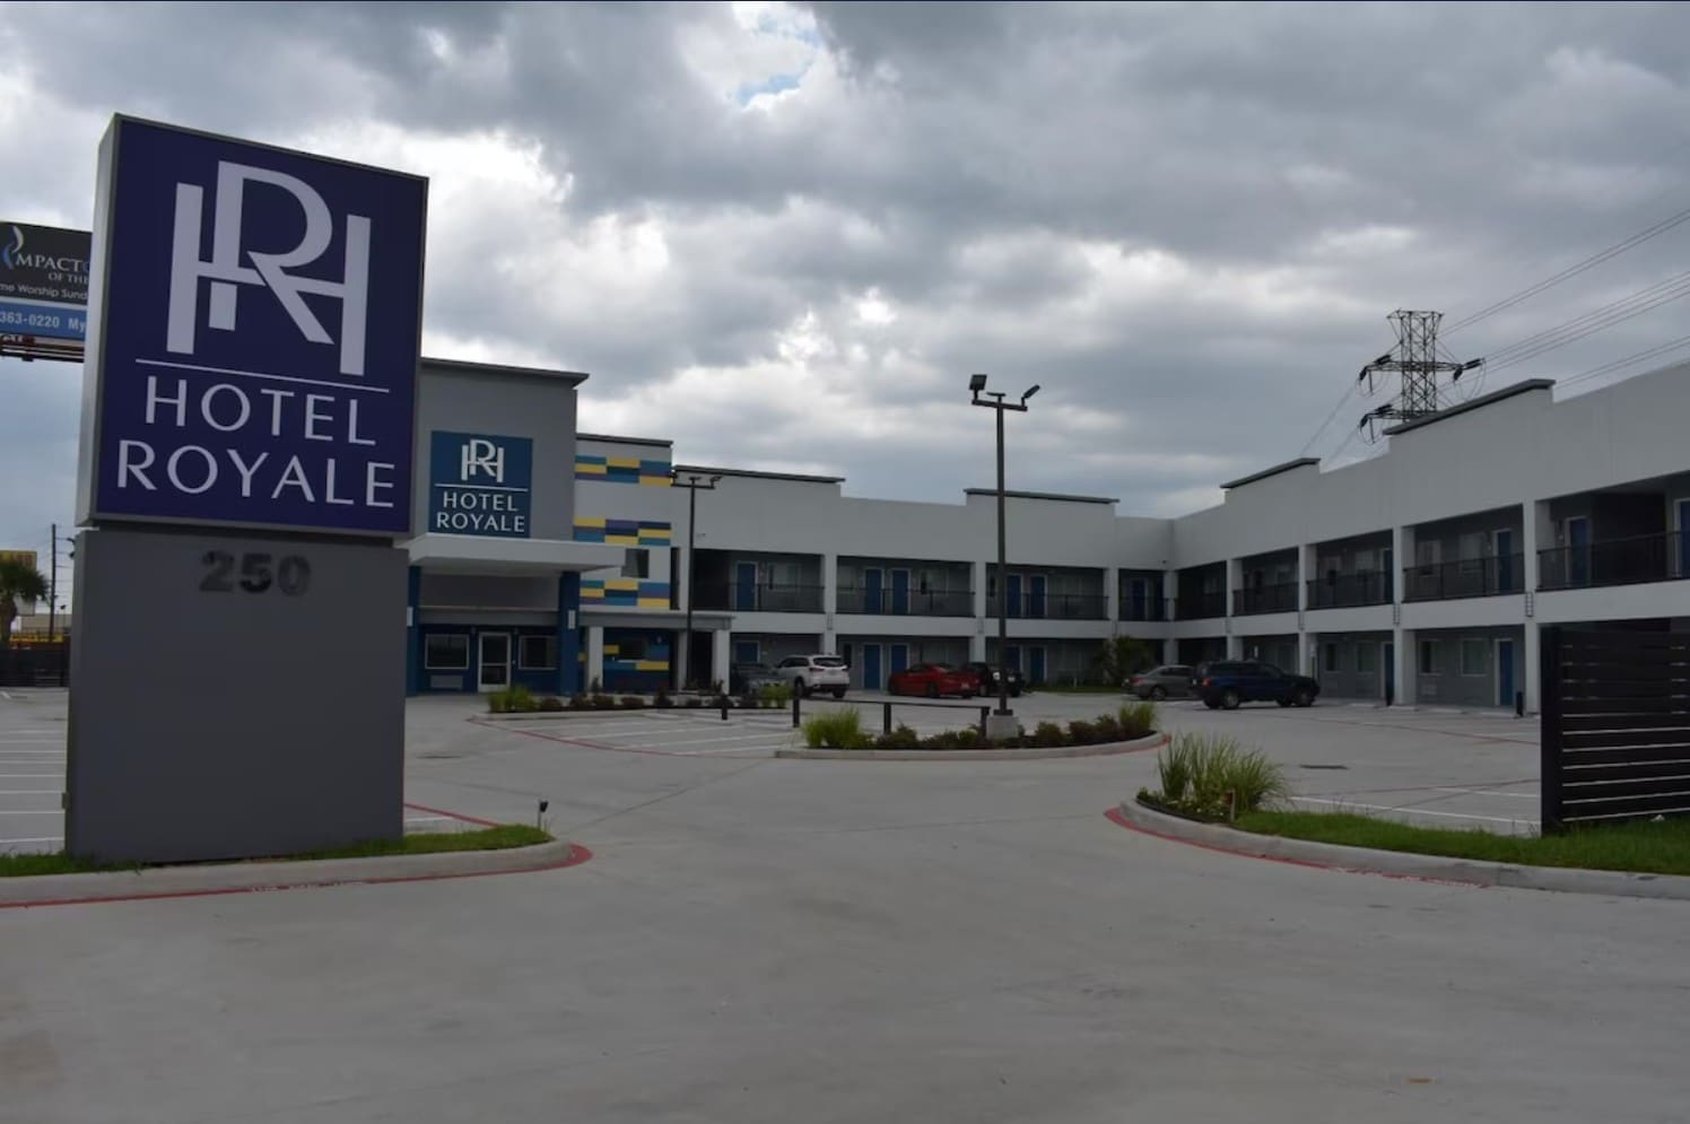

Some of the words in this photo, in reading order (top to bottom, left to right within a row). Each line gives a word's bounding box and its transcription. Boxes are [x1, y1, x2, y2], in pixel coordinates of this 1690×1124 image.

[48, 272, 62, 281] OF
[17, 284, 60, 298] Worship
[0, 310, 60, 328] 363-0220
[68, 317, 86, 333] My
[145, 375, 376, 446] HOTEL
[117, 440, 395, 508] ROYALE
[443, 491, 518, 512] HOTEL
[436, 512, 525, 533] ROYALE
[200, 551, 312, 597] 250
